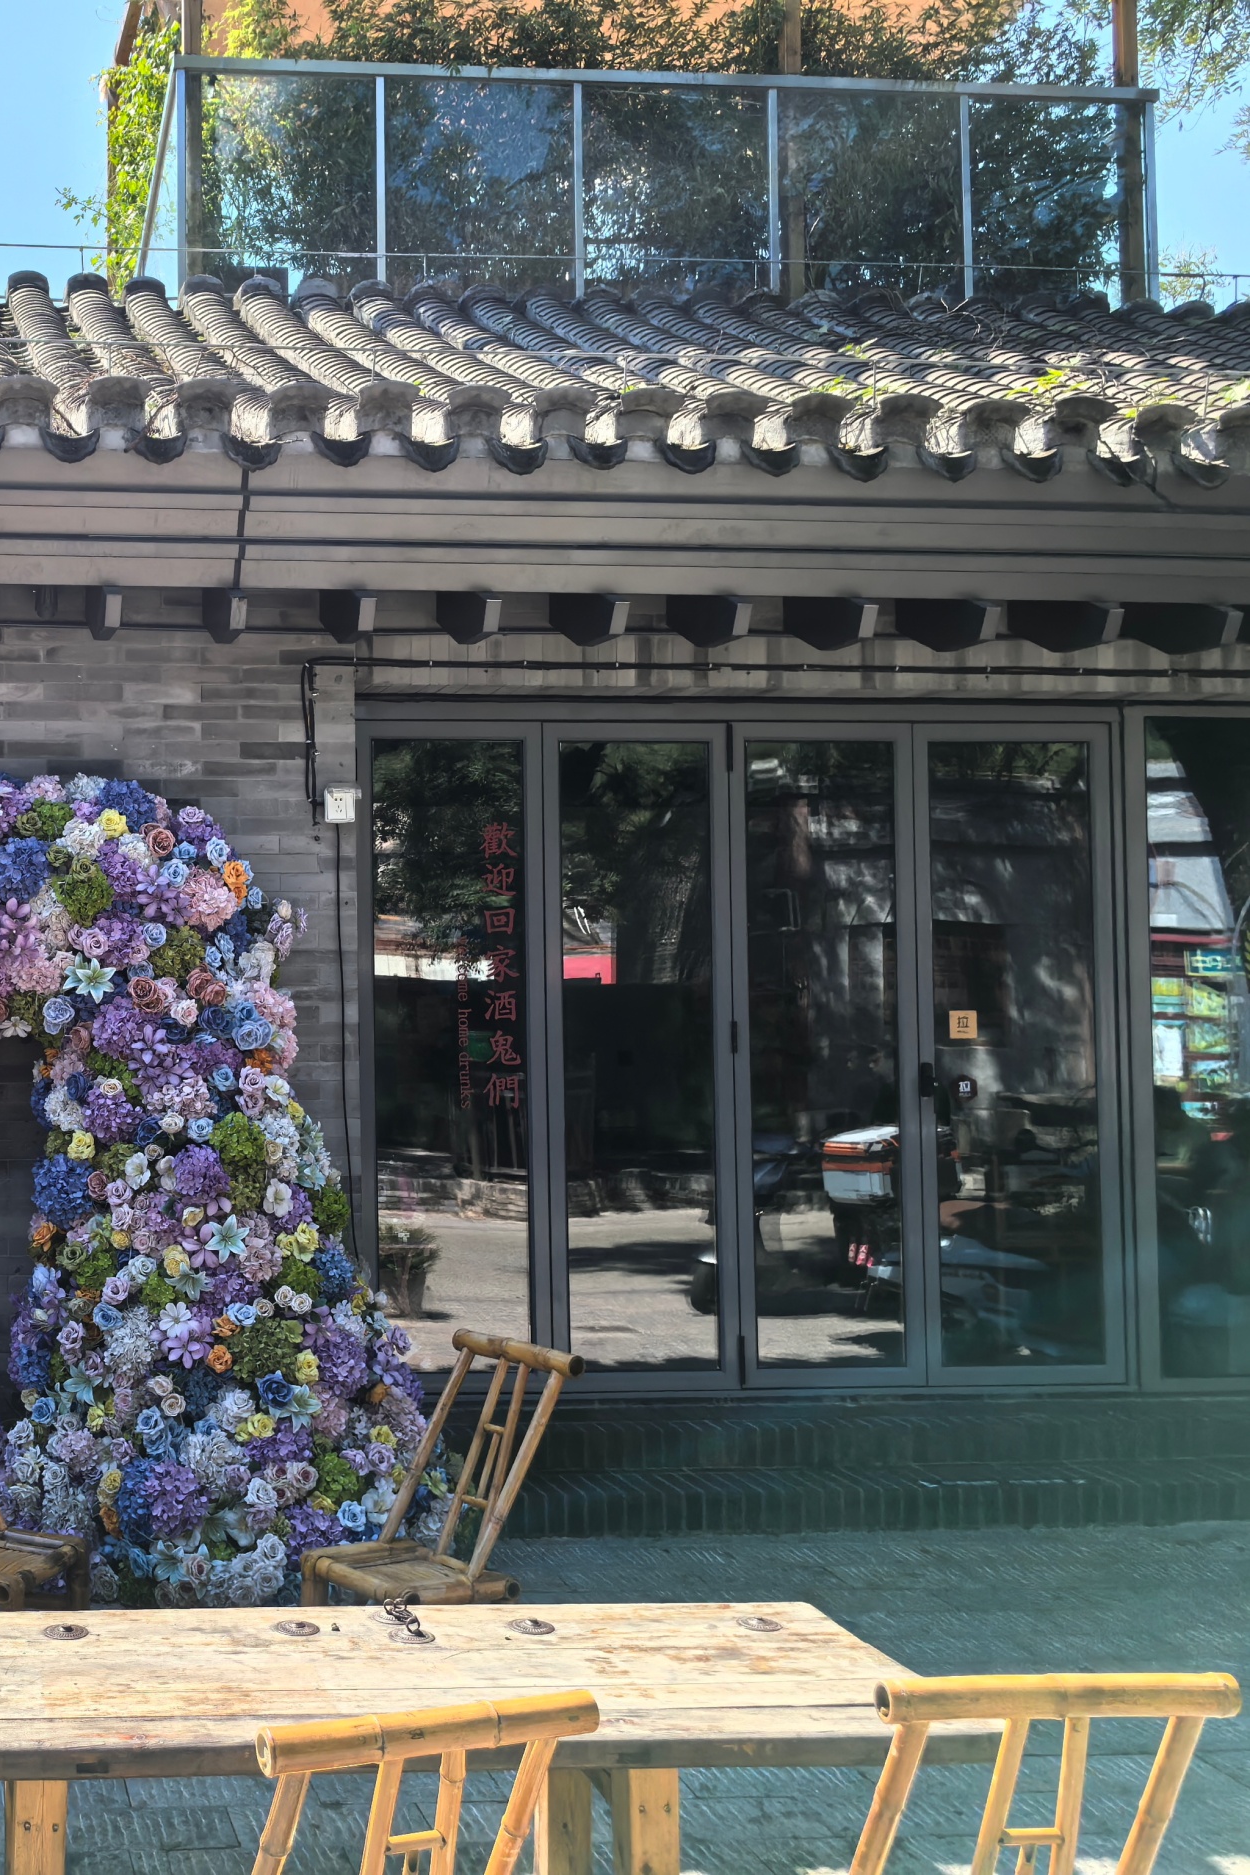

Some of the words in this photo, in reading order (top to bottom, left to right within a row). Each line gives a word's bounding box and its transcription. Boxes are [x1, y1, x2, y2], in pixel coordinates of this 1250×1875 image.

[479, 821, 521, 1110] 歡迎回家酒鬼們
[458, 1008, 472, 1047] home
[459, 1051, 475, 1110] drunks
